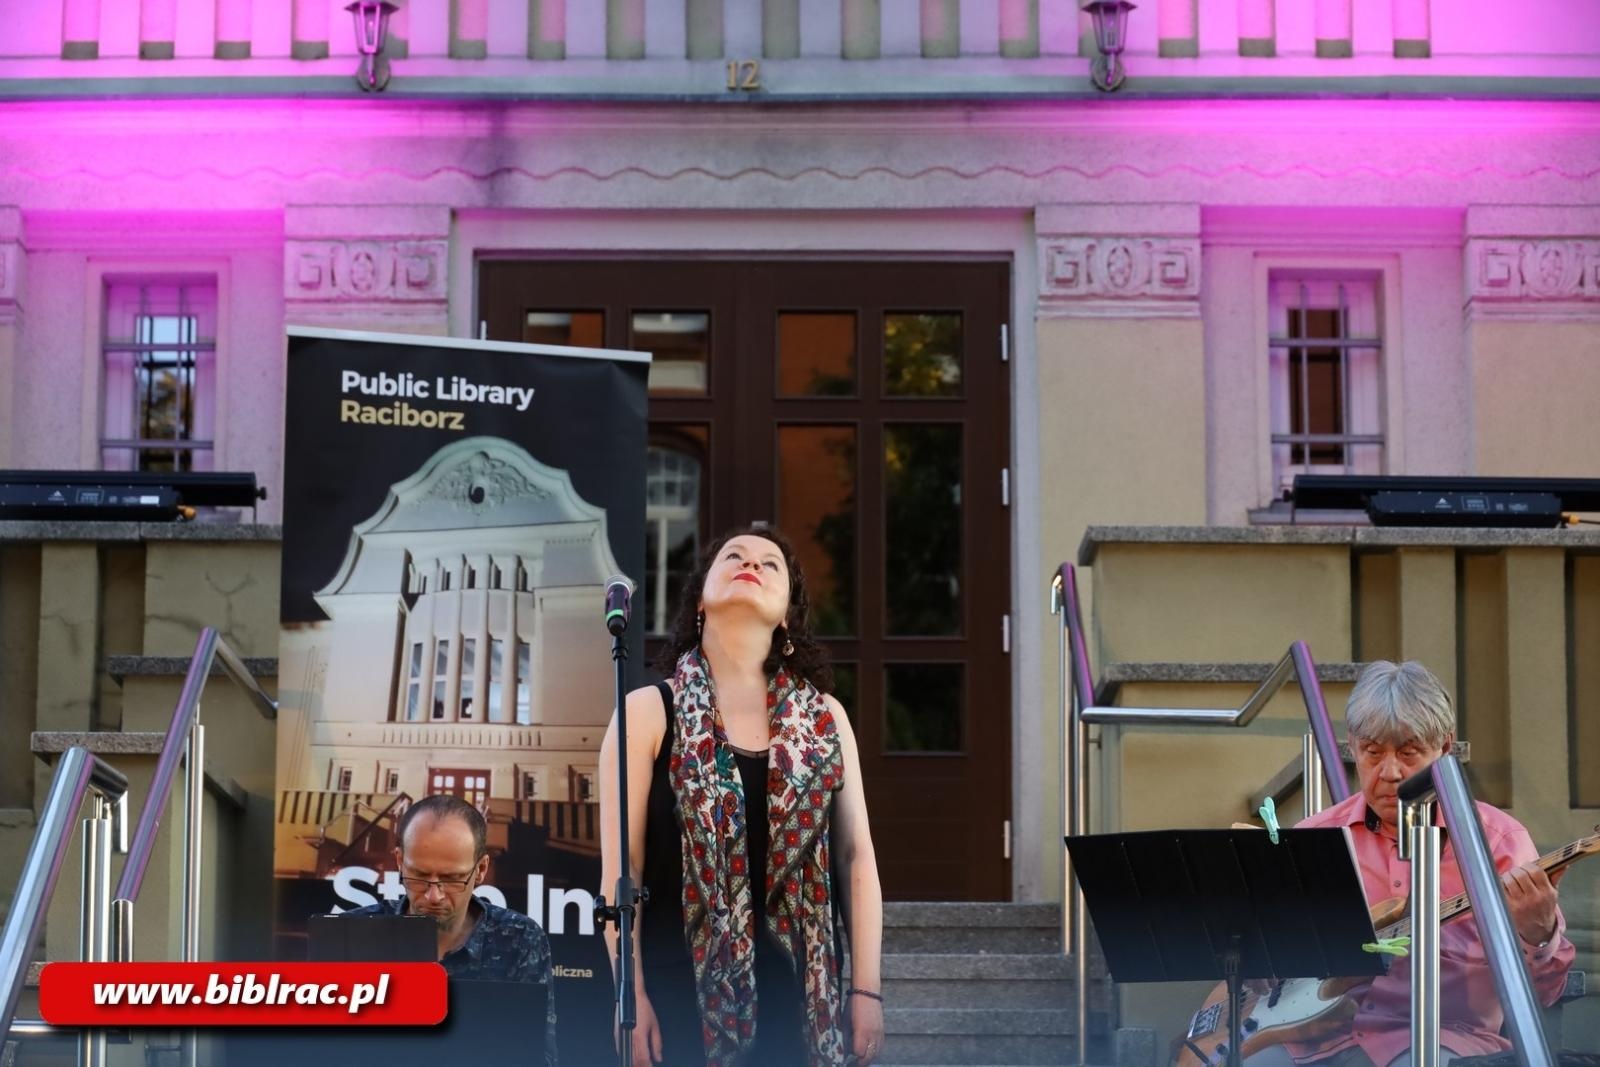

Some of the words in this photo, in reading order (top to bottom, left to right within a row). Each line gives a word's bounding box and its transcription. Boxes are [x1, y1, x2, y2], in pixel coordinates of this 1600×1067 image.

[727, 61, 760, 90] 12
[341, 370, 430, 398] Public
[436, 376, 535, 411] Library
[340, 400, 465, 430] Raciborz
[330, 866, 508, 915] St
[527, 873, 595, 936] In
